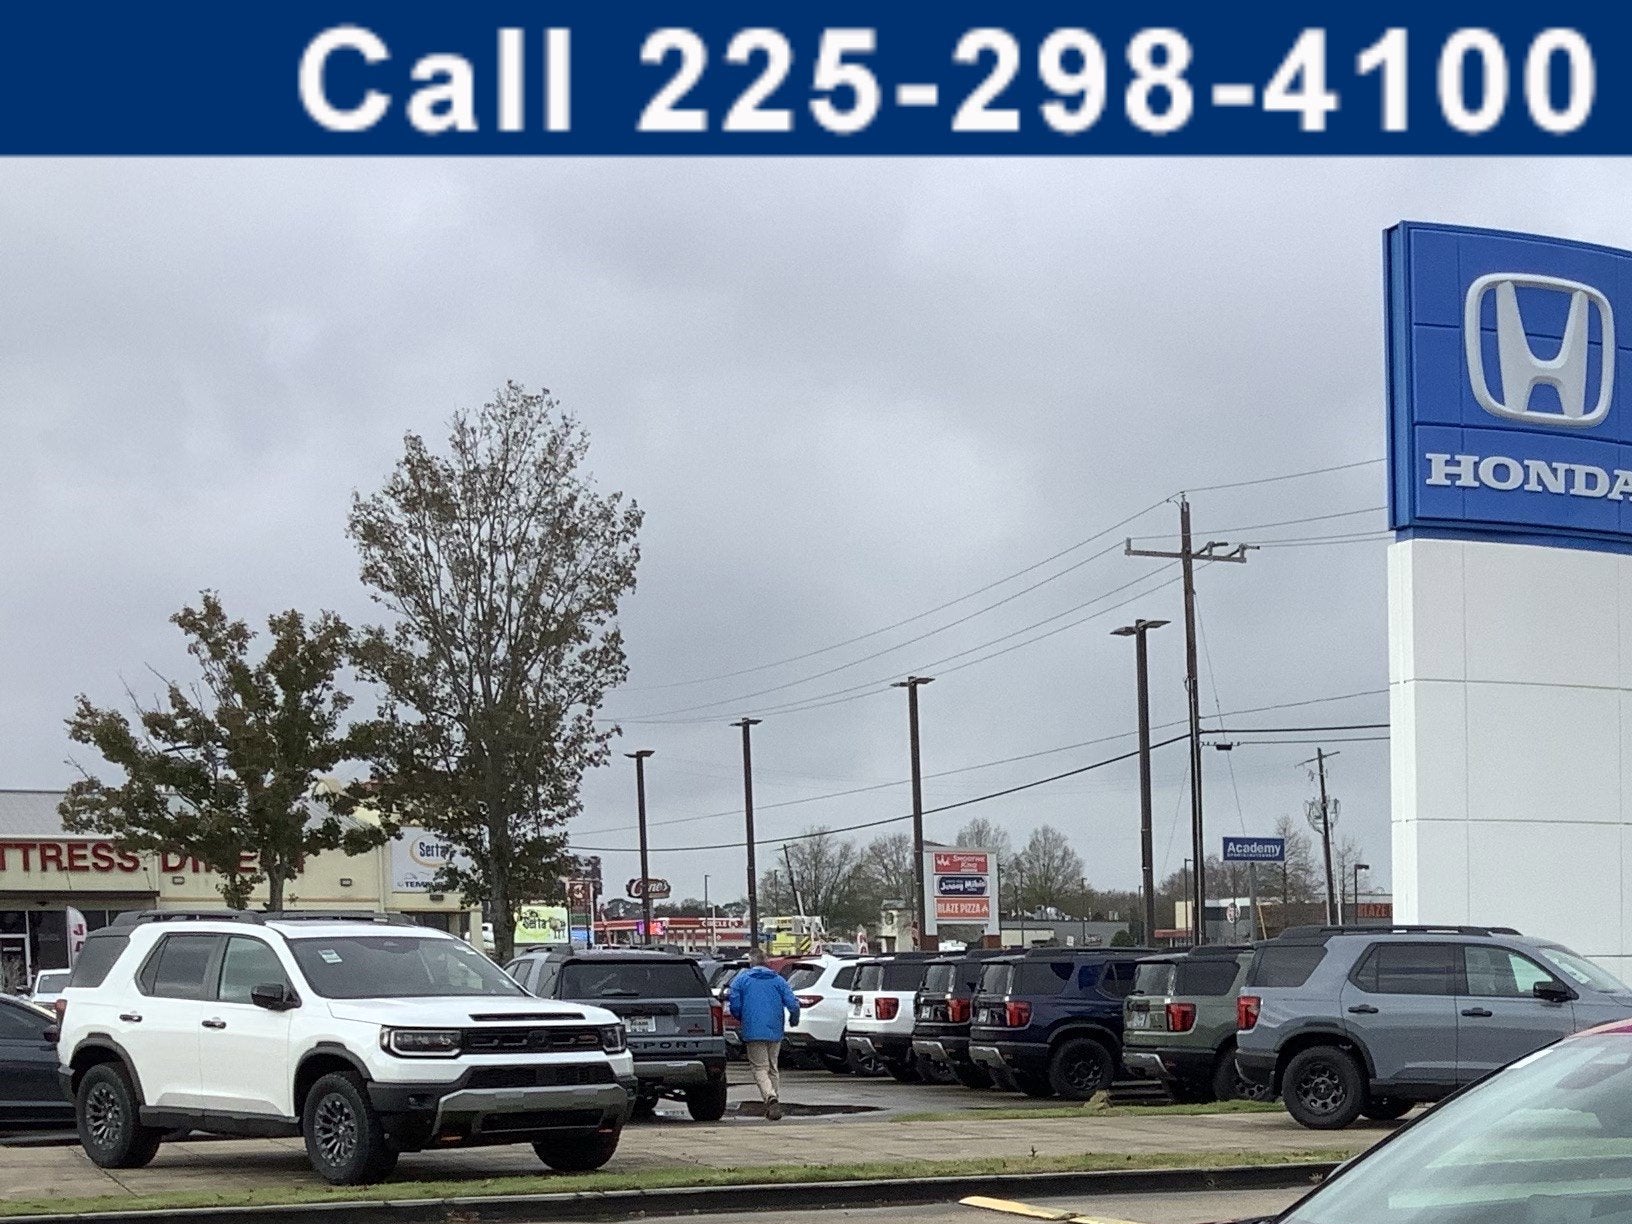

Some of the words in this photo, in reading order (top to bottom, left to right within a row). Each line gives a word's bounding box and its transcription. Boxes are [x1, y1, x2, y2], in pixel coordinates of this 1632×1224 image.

[1227, 841, 1281, 857] Academy
[937, 903, 959, 914] BLAZE
[960, 903, 980, 914] PIZZA
